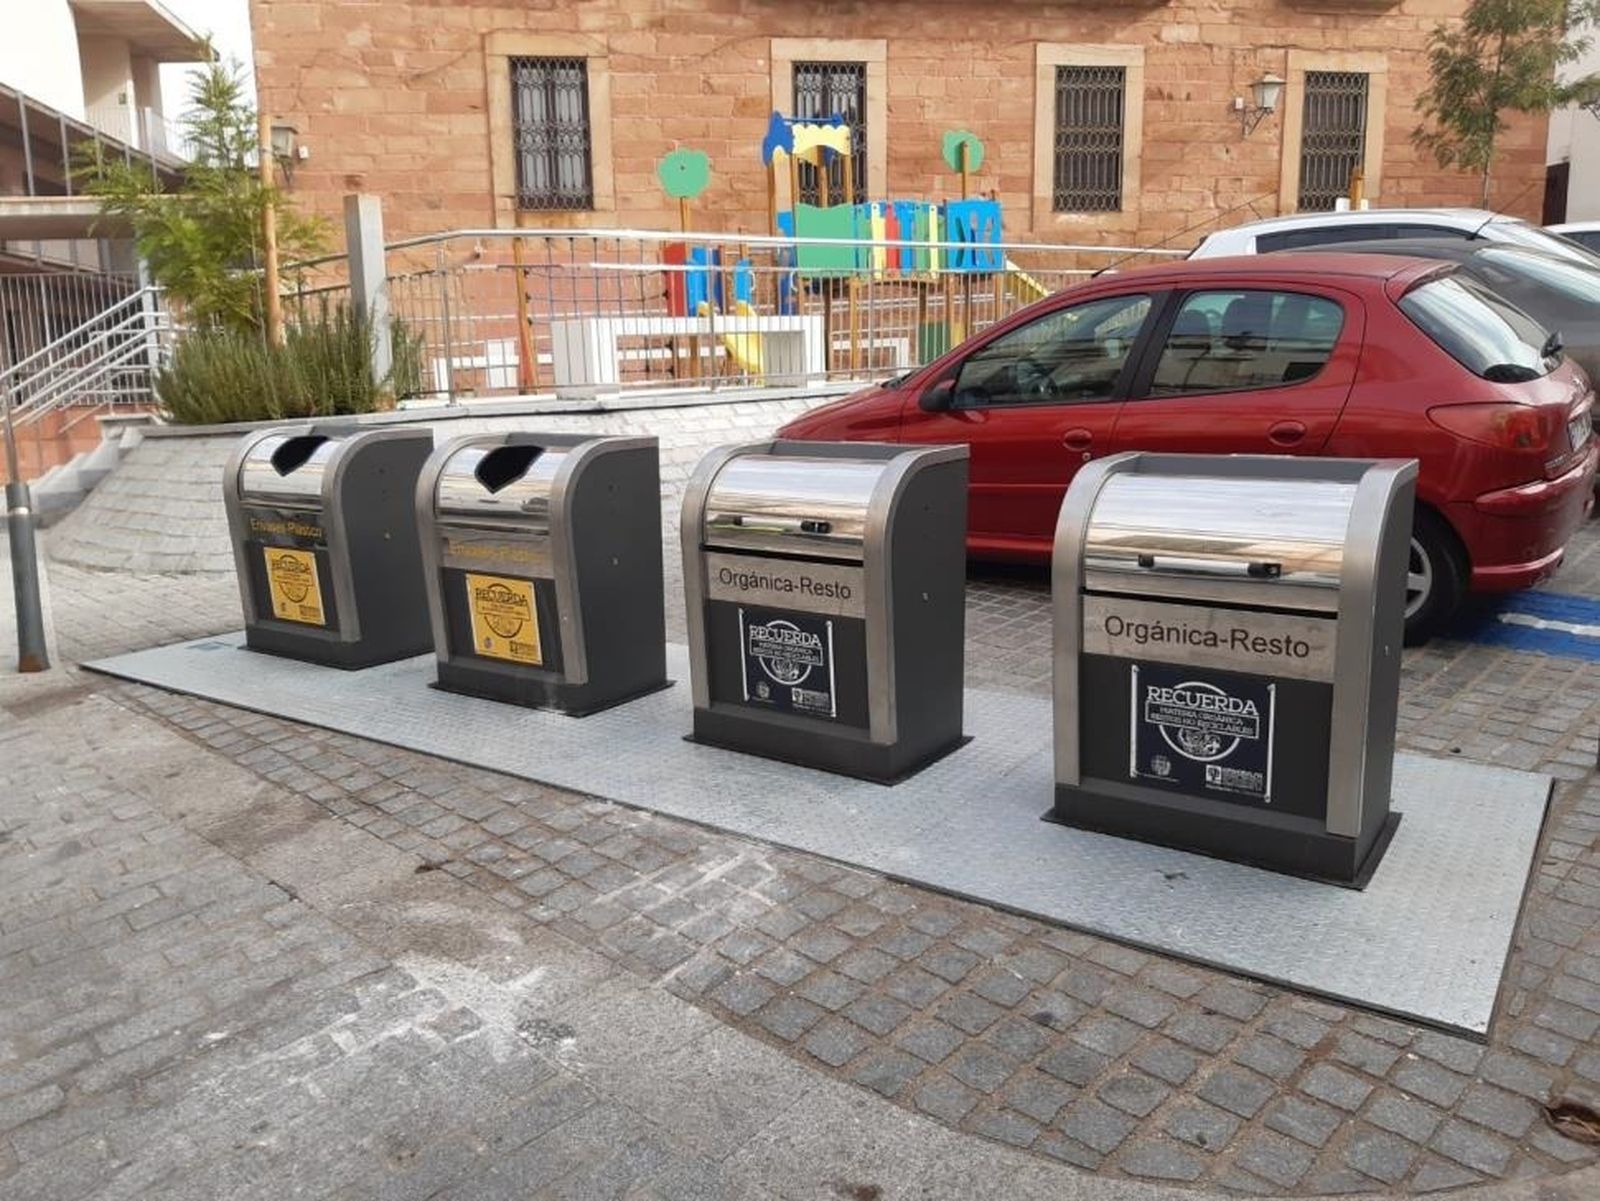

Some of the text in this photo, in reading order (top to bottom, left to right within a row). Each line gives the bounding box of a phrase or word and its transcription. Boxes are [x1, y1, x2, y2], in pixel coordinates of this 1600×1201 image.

[719, 567, 852, 600] Orgánica-Resto
[749, 625, 822, 647] RECUERDA
[1104, 615, 1310, 659] Orgánica-Resto
[1147, 686, 1260, 716] RECUERDA
